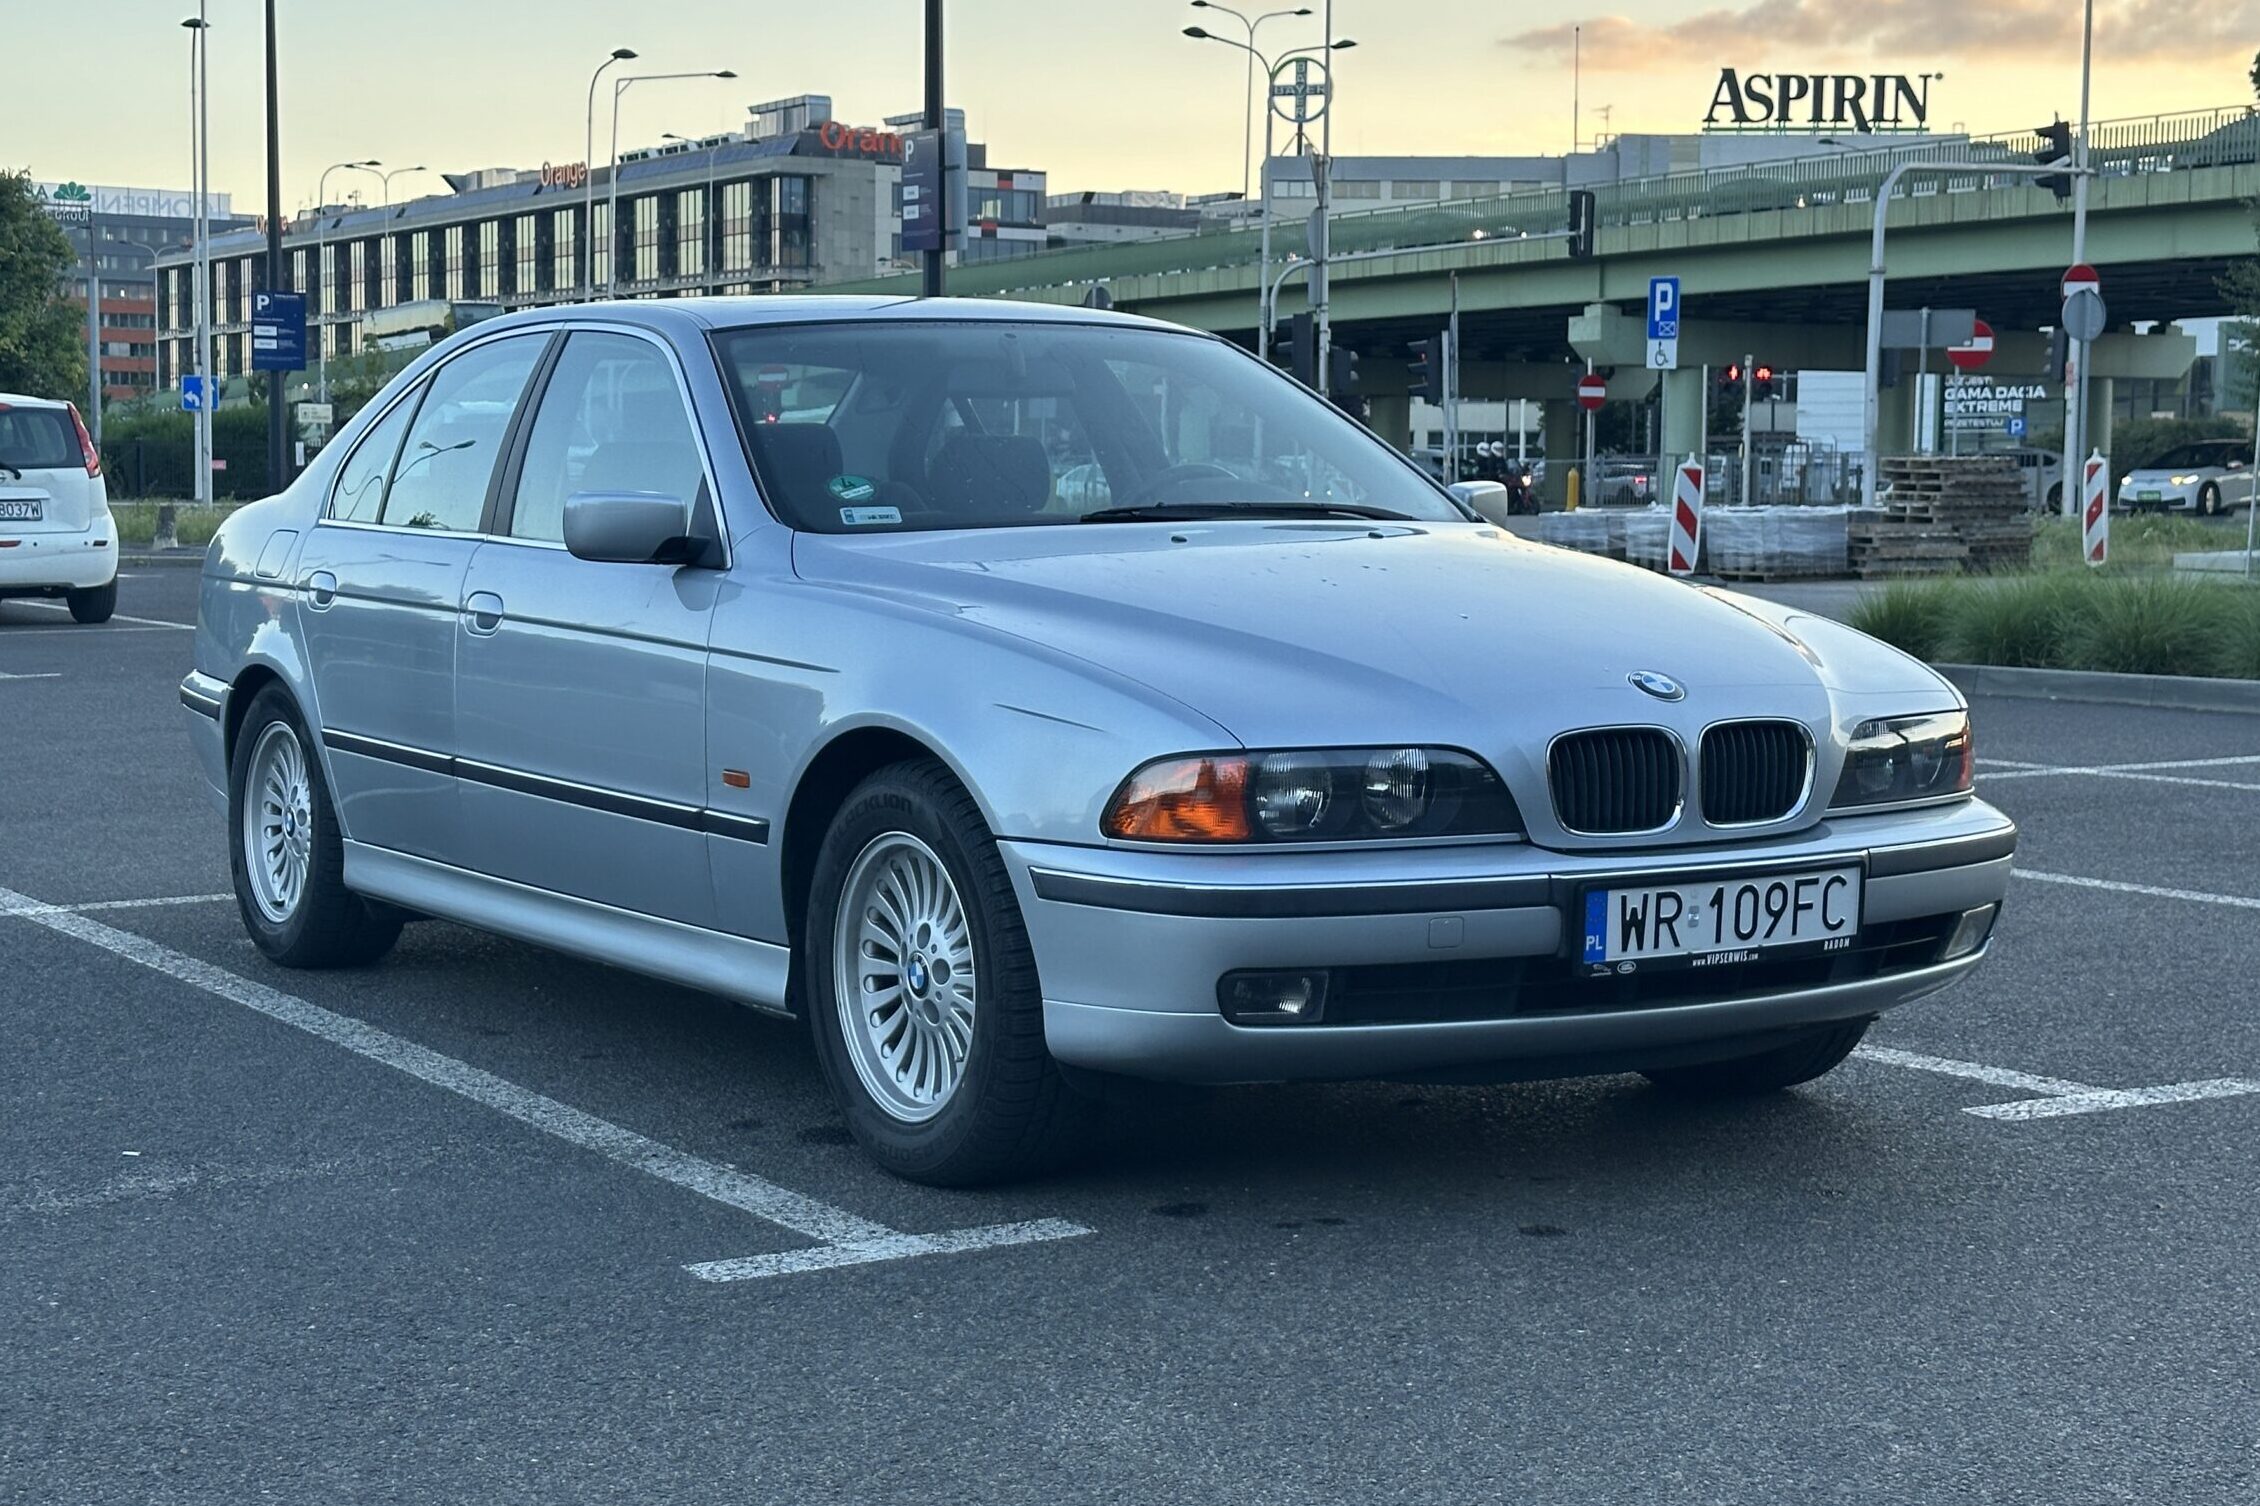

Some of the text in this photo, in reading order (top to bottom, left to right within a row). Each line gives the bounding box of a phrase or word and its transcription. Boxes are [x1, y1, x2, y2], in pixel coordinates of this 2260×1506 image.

[820, 121, 903, 154] Oran
[905, 140, 914, 162] P
[541, 161, 587, 188] Orange
[256, 295, 270, 311] P
[1655, 283, 1673, 322] P
[1944, 385, 2046, 400] GAMA DACIA
[1944, 400, 2022, 413] EXTREME
[2011, 419, 2023, 435] P
[1620, 874, 1848, 952] WR 109FC
[1586, 935, 1602, 951] PL
[1824, 937, 1850, 950] RADOM
